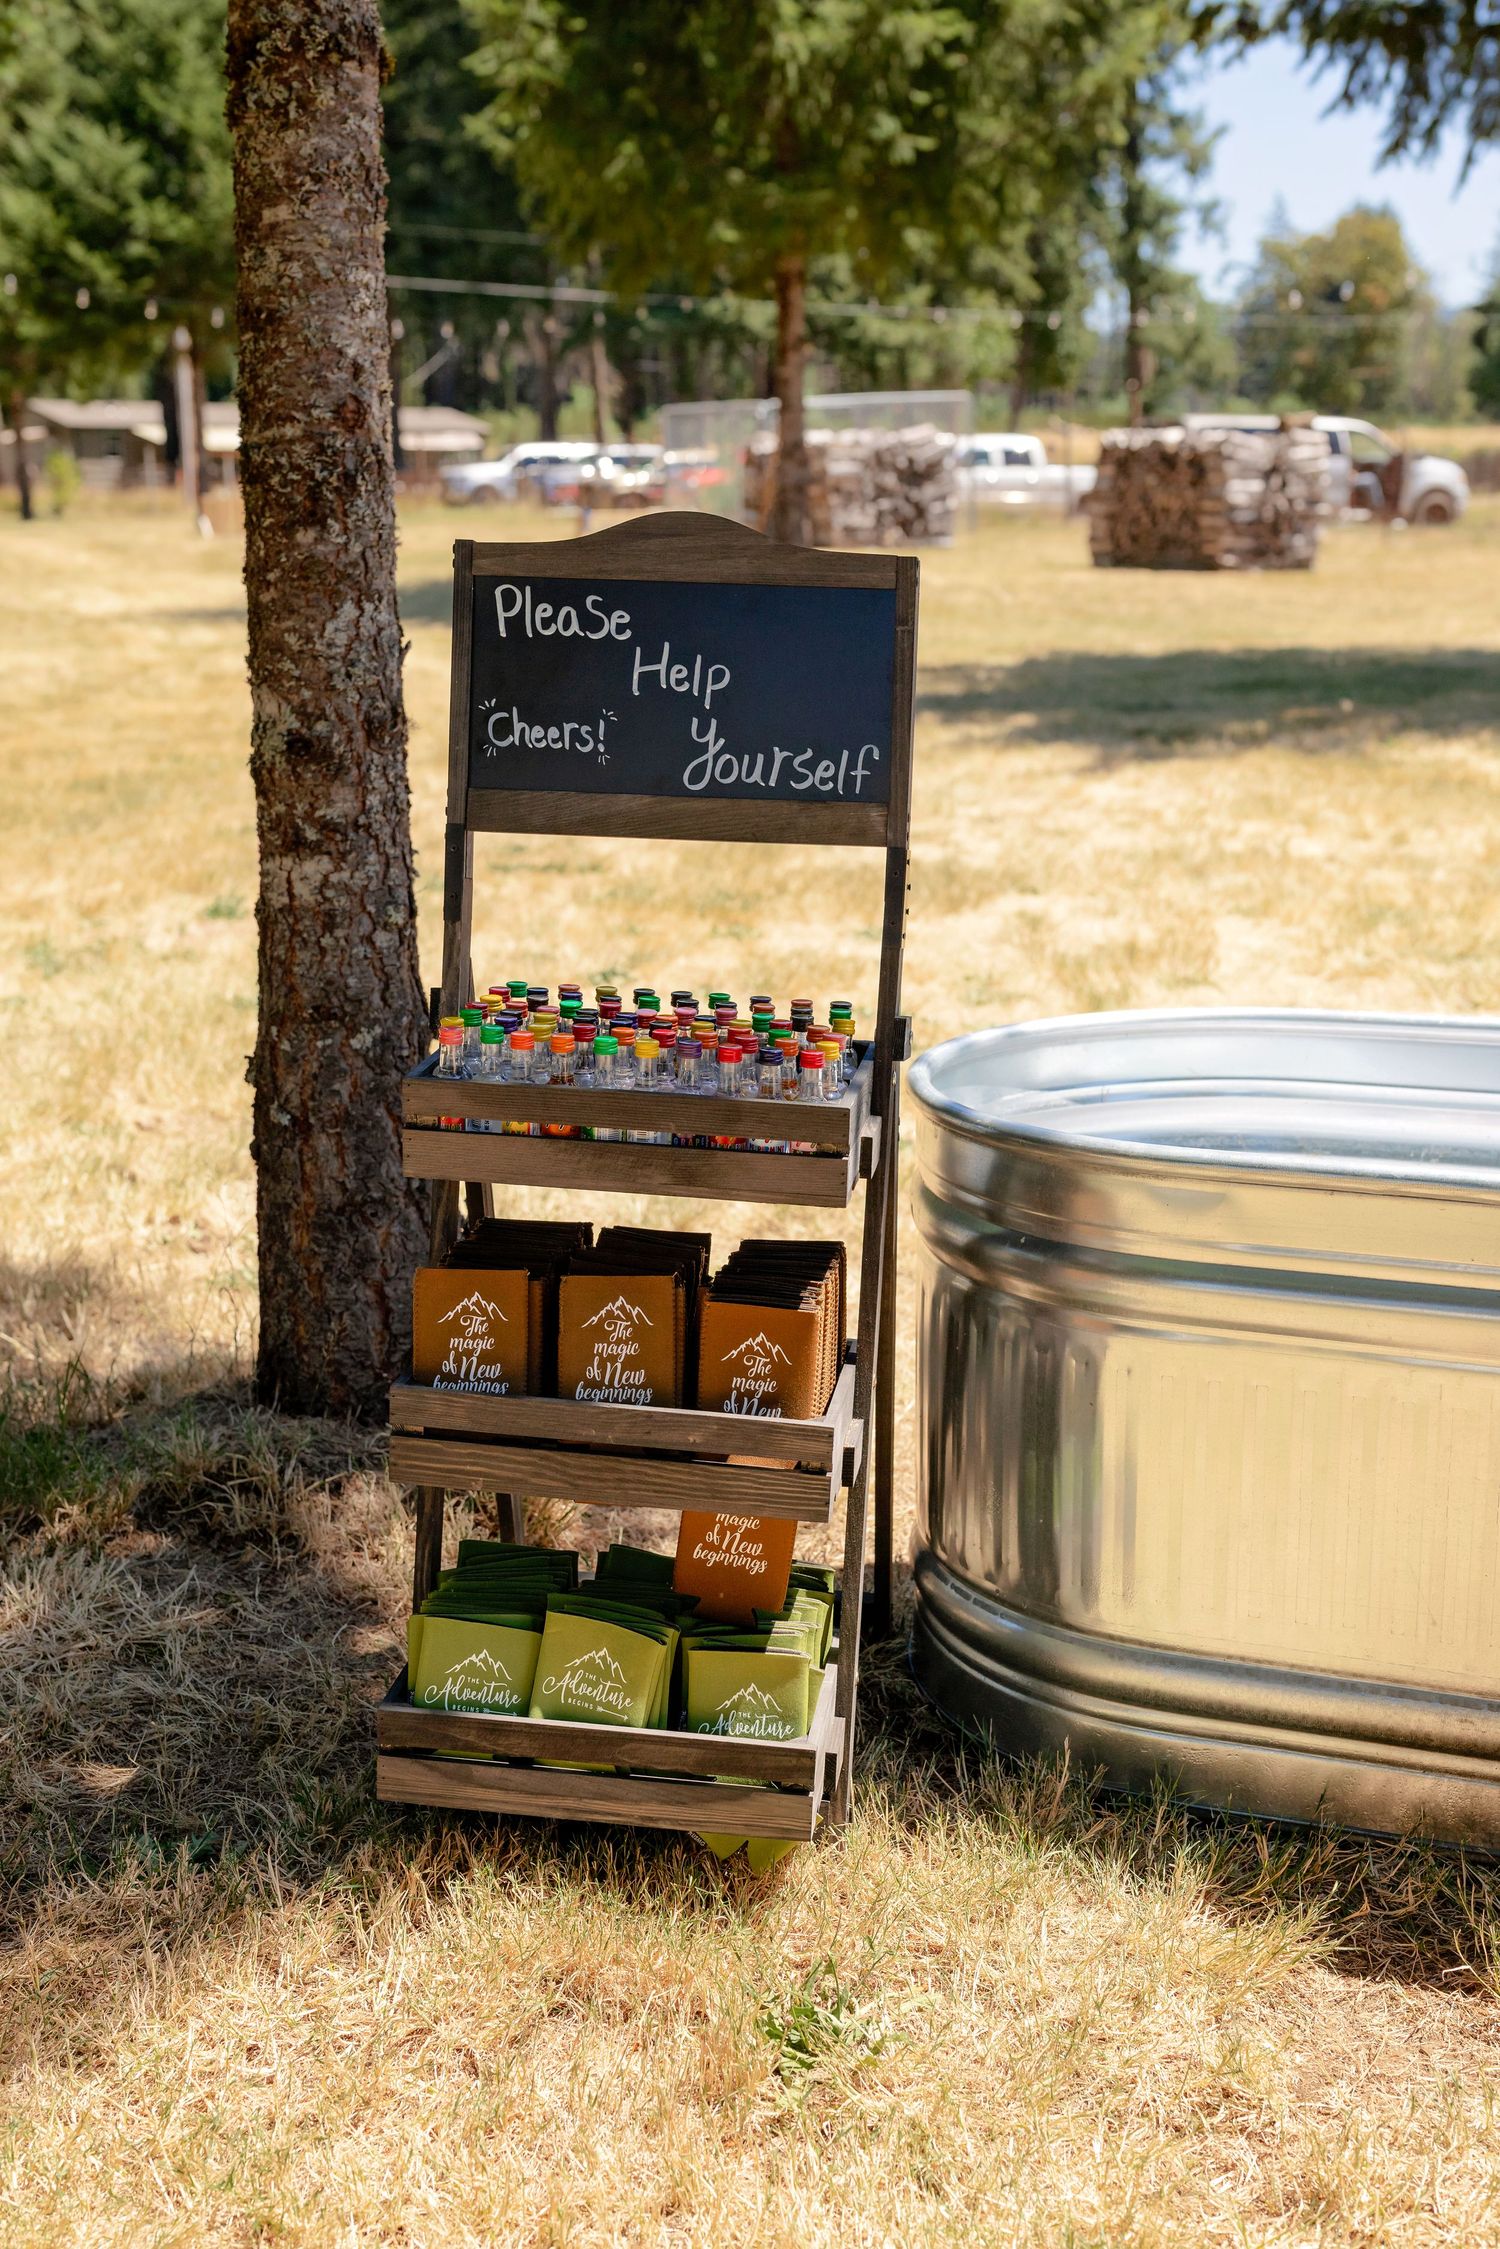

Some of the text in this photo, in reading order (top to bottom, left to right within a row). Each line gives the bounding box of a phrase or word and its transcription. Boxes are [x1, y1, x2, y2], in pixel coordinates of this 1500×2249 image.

[631, 641, 731, 709] Help
[487, 707, 606, 753] Cheers!
[683, 716, 880, 795] Yourself
[460, 1314, 489, 1337] The
[604, 1319, 633, 1342] The
[449, 1336, 495, 1356] magic
[594, 1341, 641, 1362] magic
[442, 1350, 502, 1382] of New
[586, 1356, 647, 1388] of New
[743, 1354, 772, 1378] The
[575, 1381, 653, 1406] beginnings
[731, 1376, 778, 1398] magic
[723, 1390, 738, 1414] of
[715, 1513, 761, 1534] magic
[705, 1523, 764, 1556] of New
[693, 1542, 768, 1575] beginnings
[585, 1672, 597, 1681] THE
[424, 1674, 522, 1711] Adventure
[542, 1669, 634, 1709] Adventure
[452, 1704, 480, 1713] BEGINS
[567, 1697, 594, 1710] BEGINS
[697, 1709, 795, 1739] Adventure
